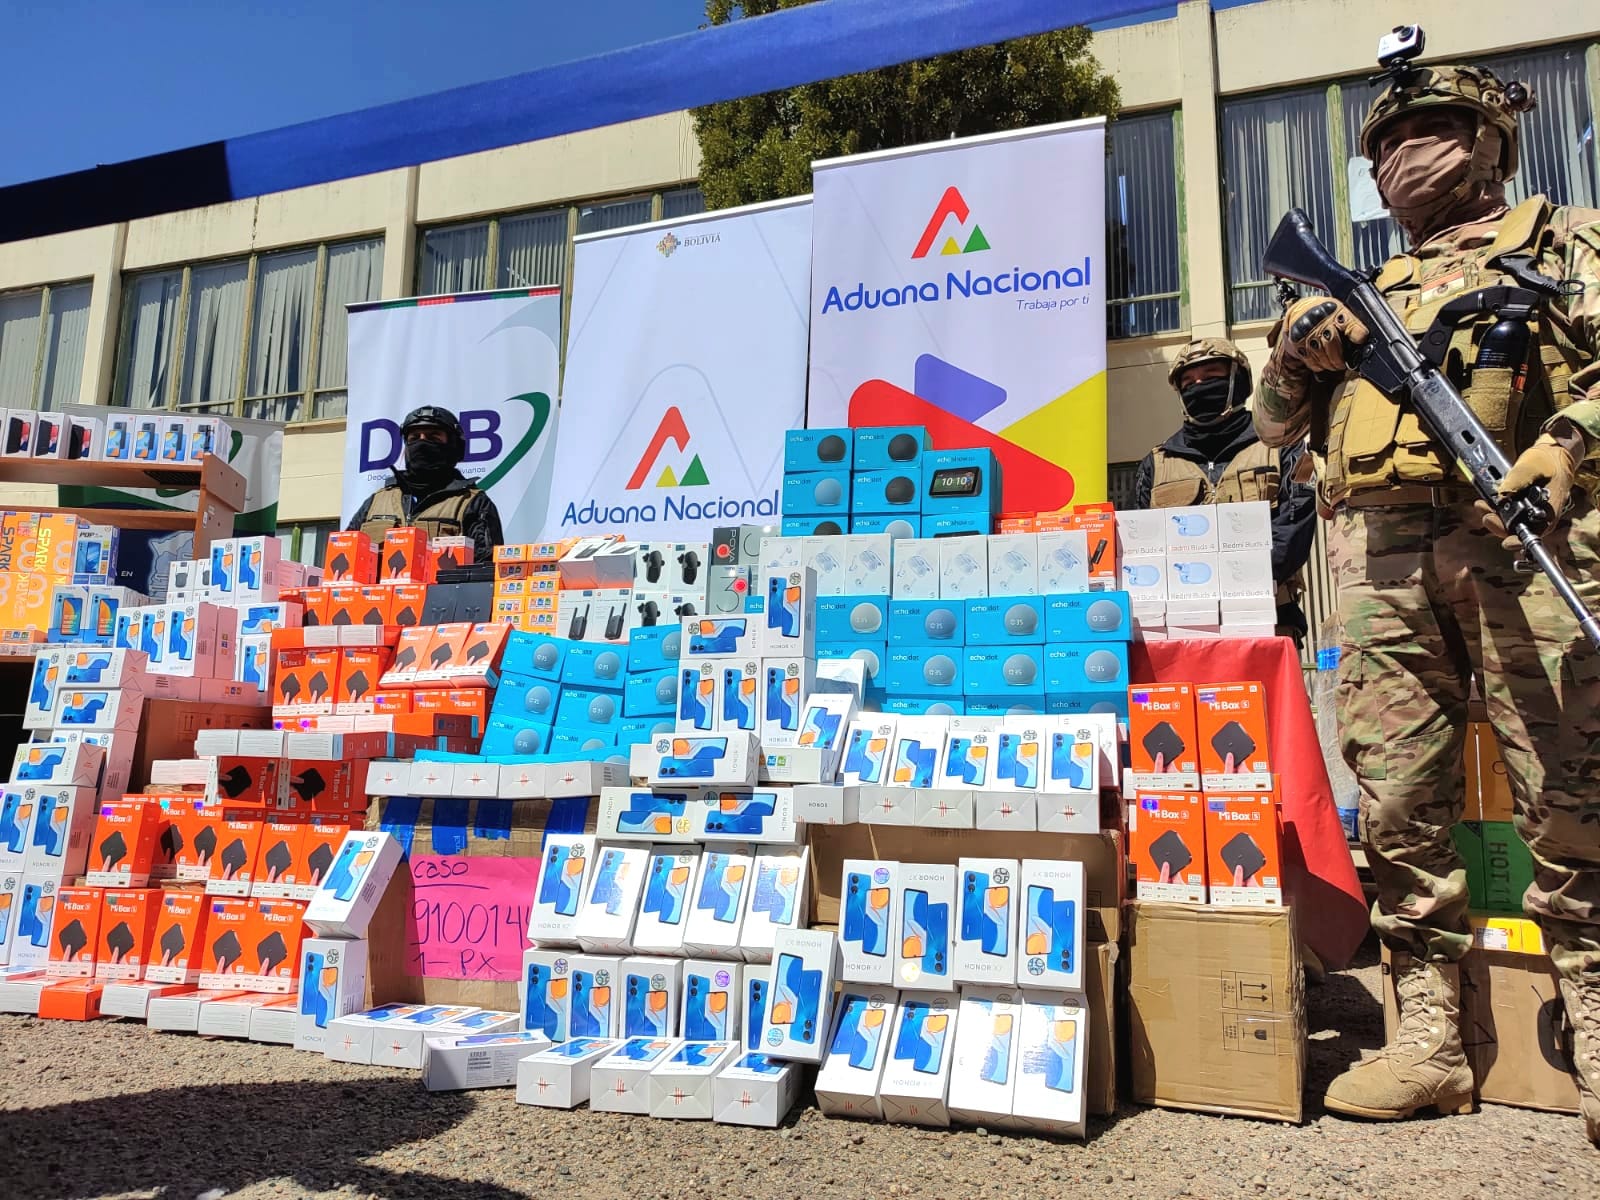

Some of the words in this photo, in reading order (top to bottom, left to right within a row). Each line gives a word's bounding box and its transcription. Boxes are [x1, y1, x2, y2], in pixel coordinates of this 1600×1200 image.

[822, 283, 939, 314] Aduana
[947, 257, 1091, 299] Nacional
[1016, 299, 1057, 312] Trabaja
[1059, 297, 1080, 310] por
[1082, 293, 1090, 305] ti
[360, 410, 503, 472] DB
[561, 499, 656, 526] Aduana
[664, 490, 779, 521] Nacional
[34, 528, 51, 573] SPARK
[1153, 702, 1170, 710] Box
[1209, 702, 1221, 710] Mi
[1222, 701, 1240, 709] Box
[1150, 810, 1160, 818] Mi
[1218, 811, 1231, 820] Mi
[1232, 812, 1250, 821] Box
[114, 815, 126, 823] Box
[236, 822, 247, 830] Box
[323, 825, 334, 833] Box
[1489, 842, 1510, 880] HOT
[414, 860, 469, 879] caso
[119, 905, 130, 913] Box
[226, 913, 239, 921] Box
[272, 913, 286, 922] Box
[964, 963, 992, 971] HONOR
